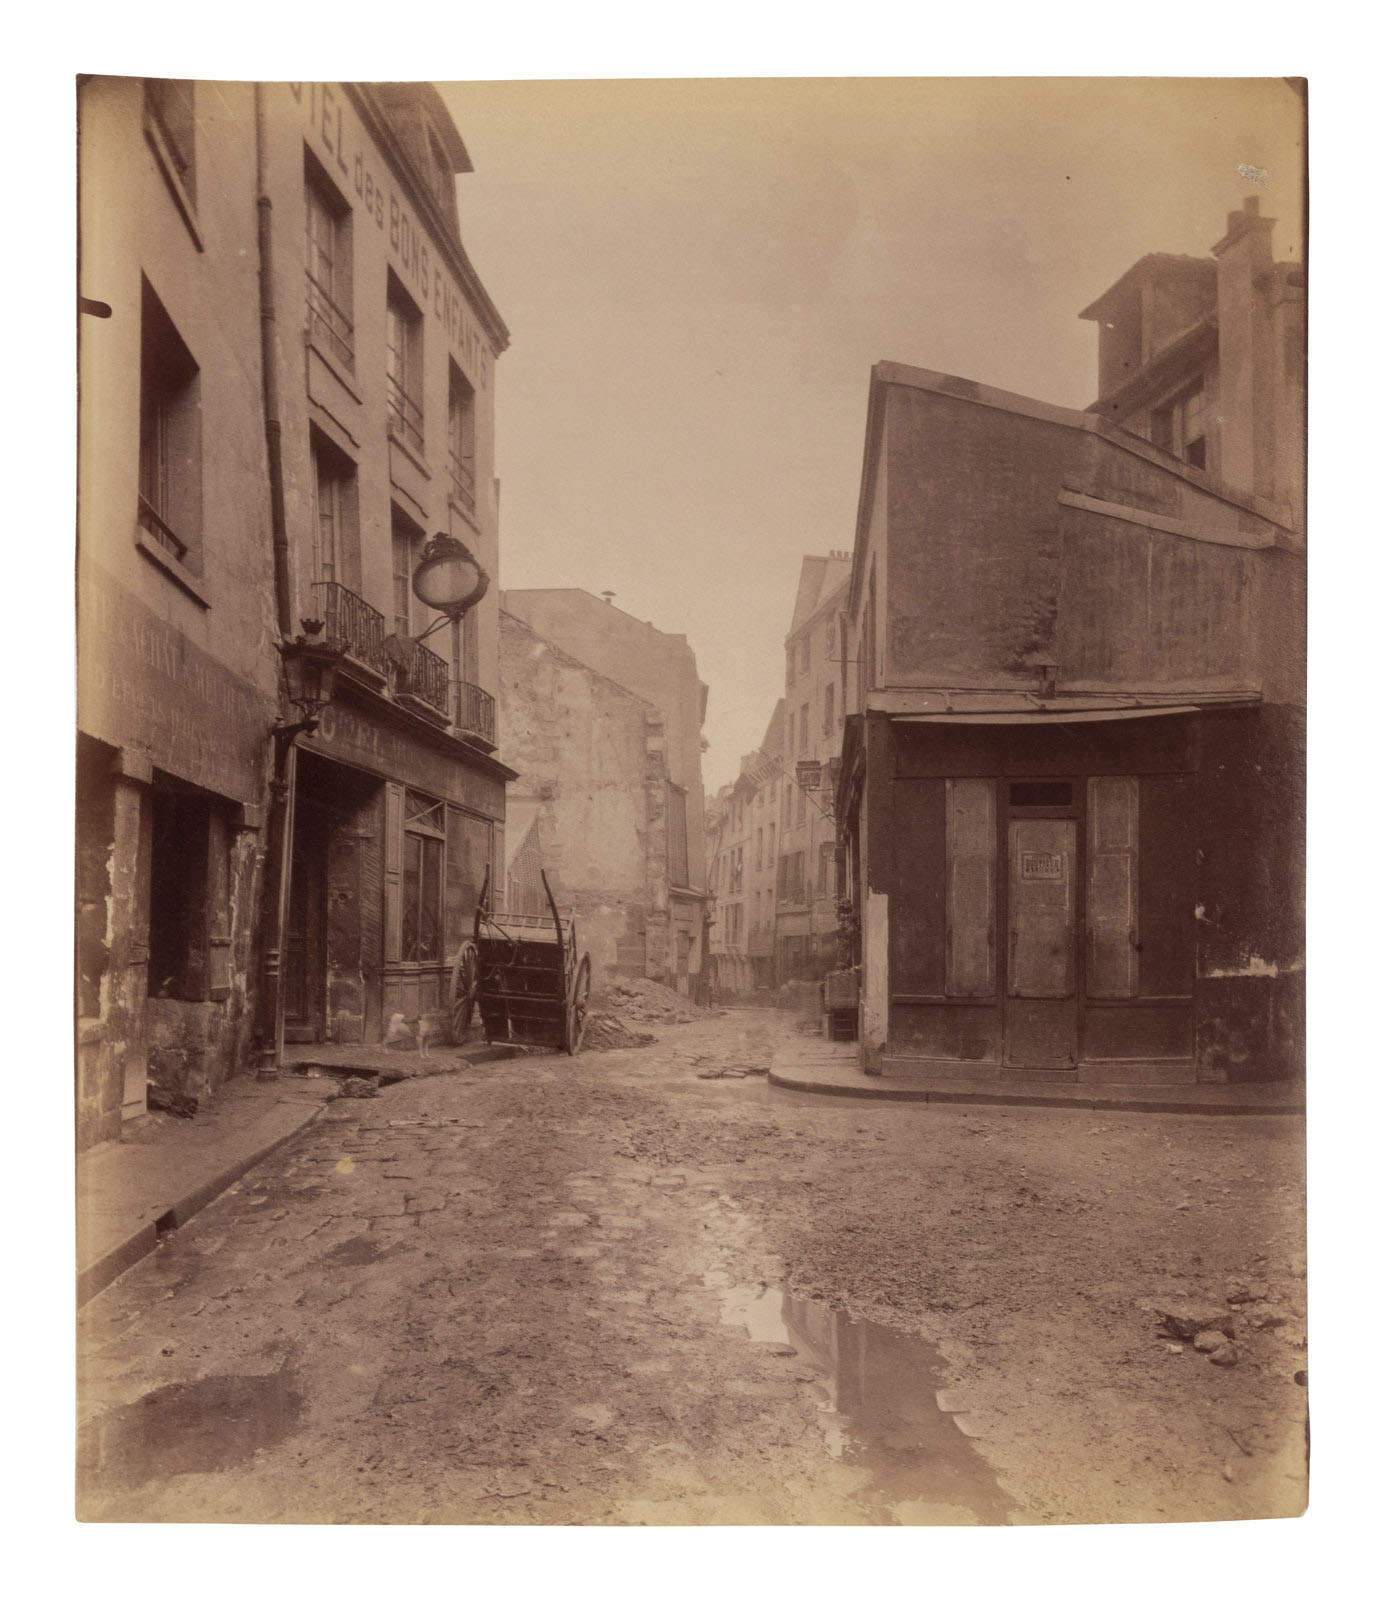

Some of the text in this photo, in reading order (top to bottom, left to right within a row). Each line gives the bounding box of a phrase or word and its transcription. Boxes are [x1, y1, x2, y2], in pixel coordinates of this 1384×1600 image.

[354, 151, 384, 232] des
[389, 190, 430, 300] BONS
[433, 266, 489, 391] ENFANTS
